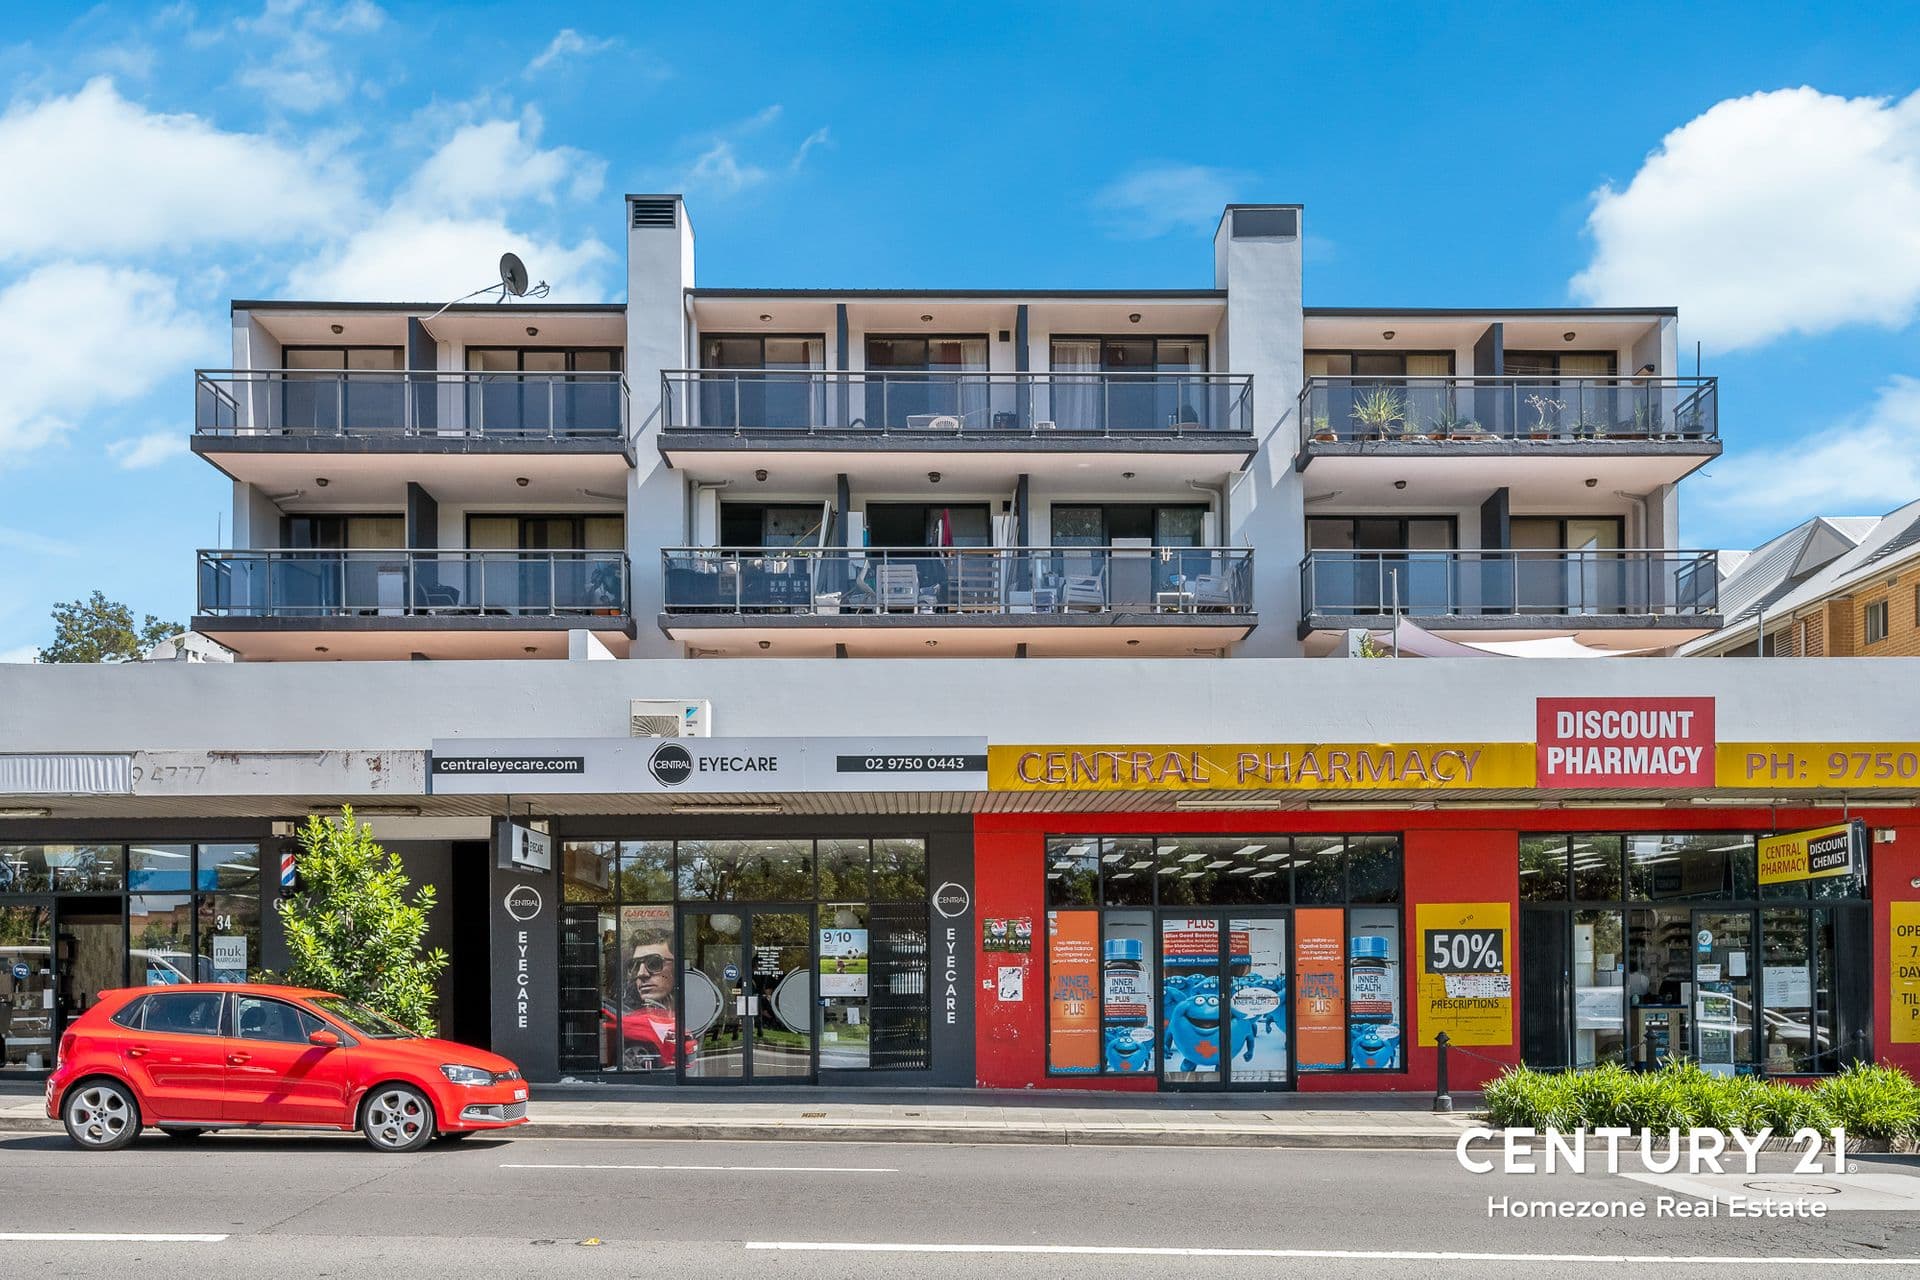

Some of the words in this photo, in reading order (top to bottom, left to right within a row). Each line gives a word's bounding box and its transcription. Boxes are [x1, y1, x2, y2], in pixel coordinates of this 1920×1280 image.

[1557, 711, 1694, 739] DISCOUNT
[440, 759, 578, 772] centraleyecare.com
[654, 760, 692, 770] CENTRAL
[699, 757, 778, 772] EYECARE
[865, 758, 884, 769] 02
[888, 758, 923, 769] 9750
[927, 758, 965, 769] 0443
[1547, 746, 1703, 775] PHARMACY
[1747, 753, 1807, 779] PH:
[1828, 752, 1919, 779] 9750
[1017, 751, 1210, 784] CENTRAL
[1237, 750, 1481, 783] PHARMACY
[1765, 843, 1802, 860] CENTRAL
[1809, 836, 1848, 856] DISCOUNT
[1813, 852, 1846, 869] CHEMIST
[1761, 857, 1807, 877] PHARMACY
[938, 896, 966, 904] CENTRAL
[624, 910, 670, 918] CARRERA
[217, 915, 231, 930] 34
[1187, 919, 1216, 929] PLUS
[824, 932, 852, 944] 9/10
[1911, 946, 1918, 957] 7
[517, 931, 529, 1028] EYECARE
[945, 928, 957, 1024] EYECARE
[1058, 976, 1089, 987] INNER
[1111, 978, 1133, 986] INNER
[1304, 973, 1335, 984] INNER
[1110, 986, 1136, 994] HEALTH
[1301, 986, 1339, 998] HEALTH
[1355, 984, 1381, 992] HEALTH
[1054, 988, 1094, 1001] HEALTH
[1115, 995, 1130, 1003] PLUS
[1063, 1003, 1086, 1016] PLUS
[1309, 1001, 1331, 1012] PLUS
[1431, 1000, 1499, 1009] PRESCRIPTIONS
